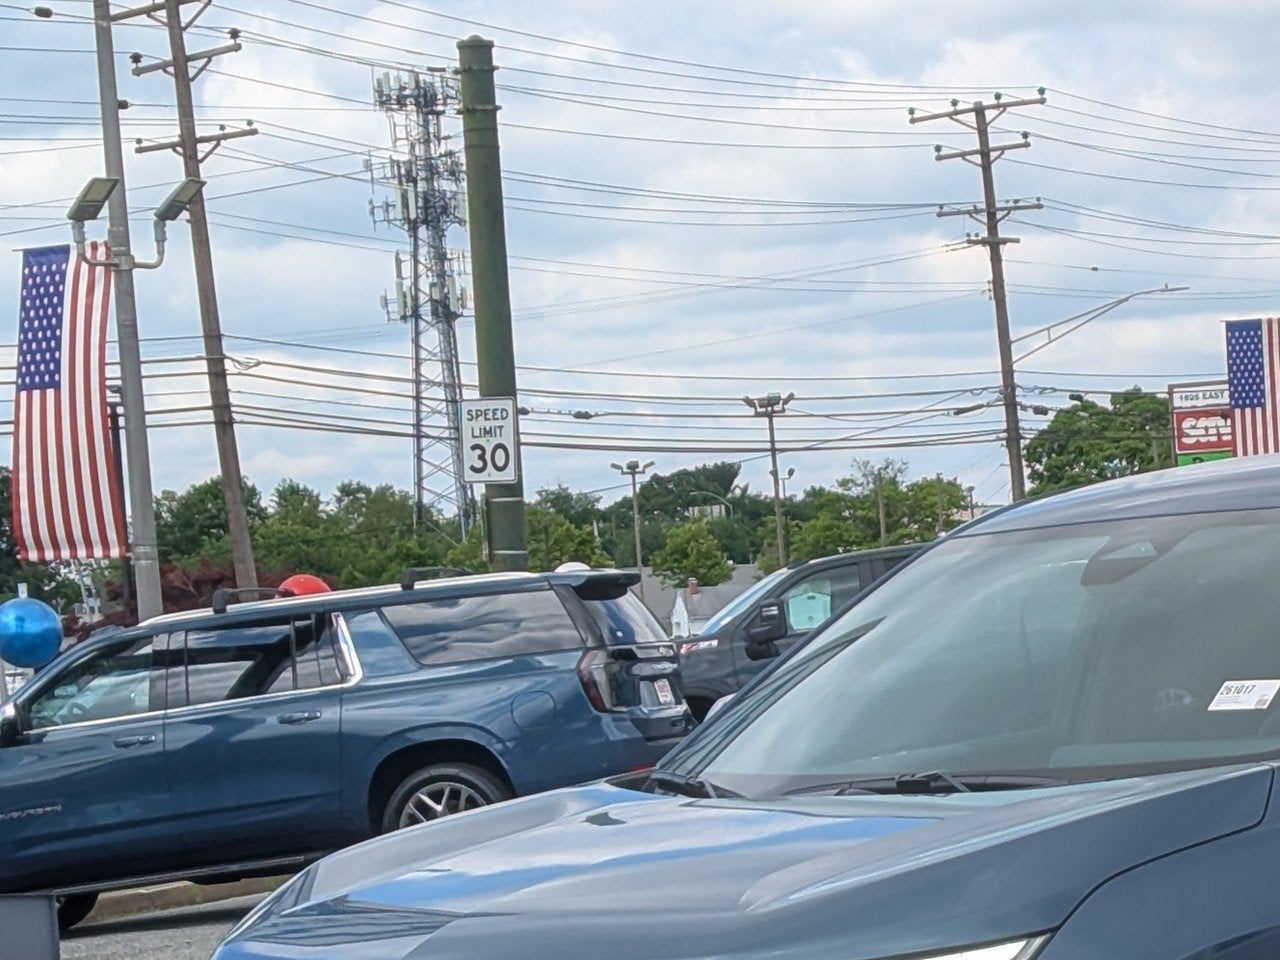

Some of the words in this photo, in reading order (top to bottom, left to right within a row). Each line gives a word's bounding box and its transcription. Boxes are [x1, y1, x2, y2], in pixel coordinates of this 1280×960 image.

[466, 407, 509, 422] SPEED
[471, 425, 505, 439] LIMIT
[468, 442, 510, 475] 30
[1219, 684, 1256, 696] 261017
